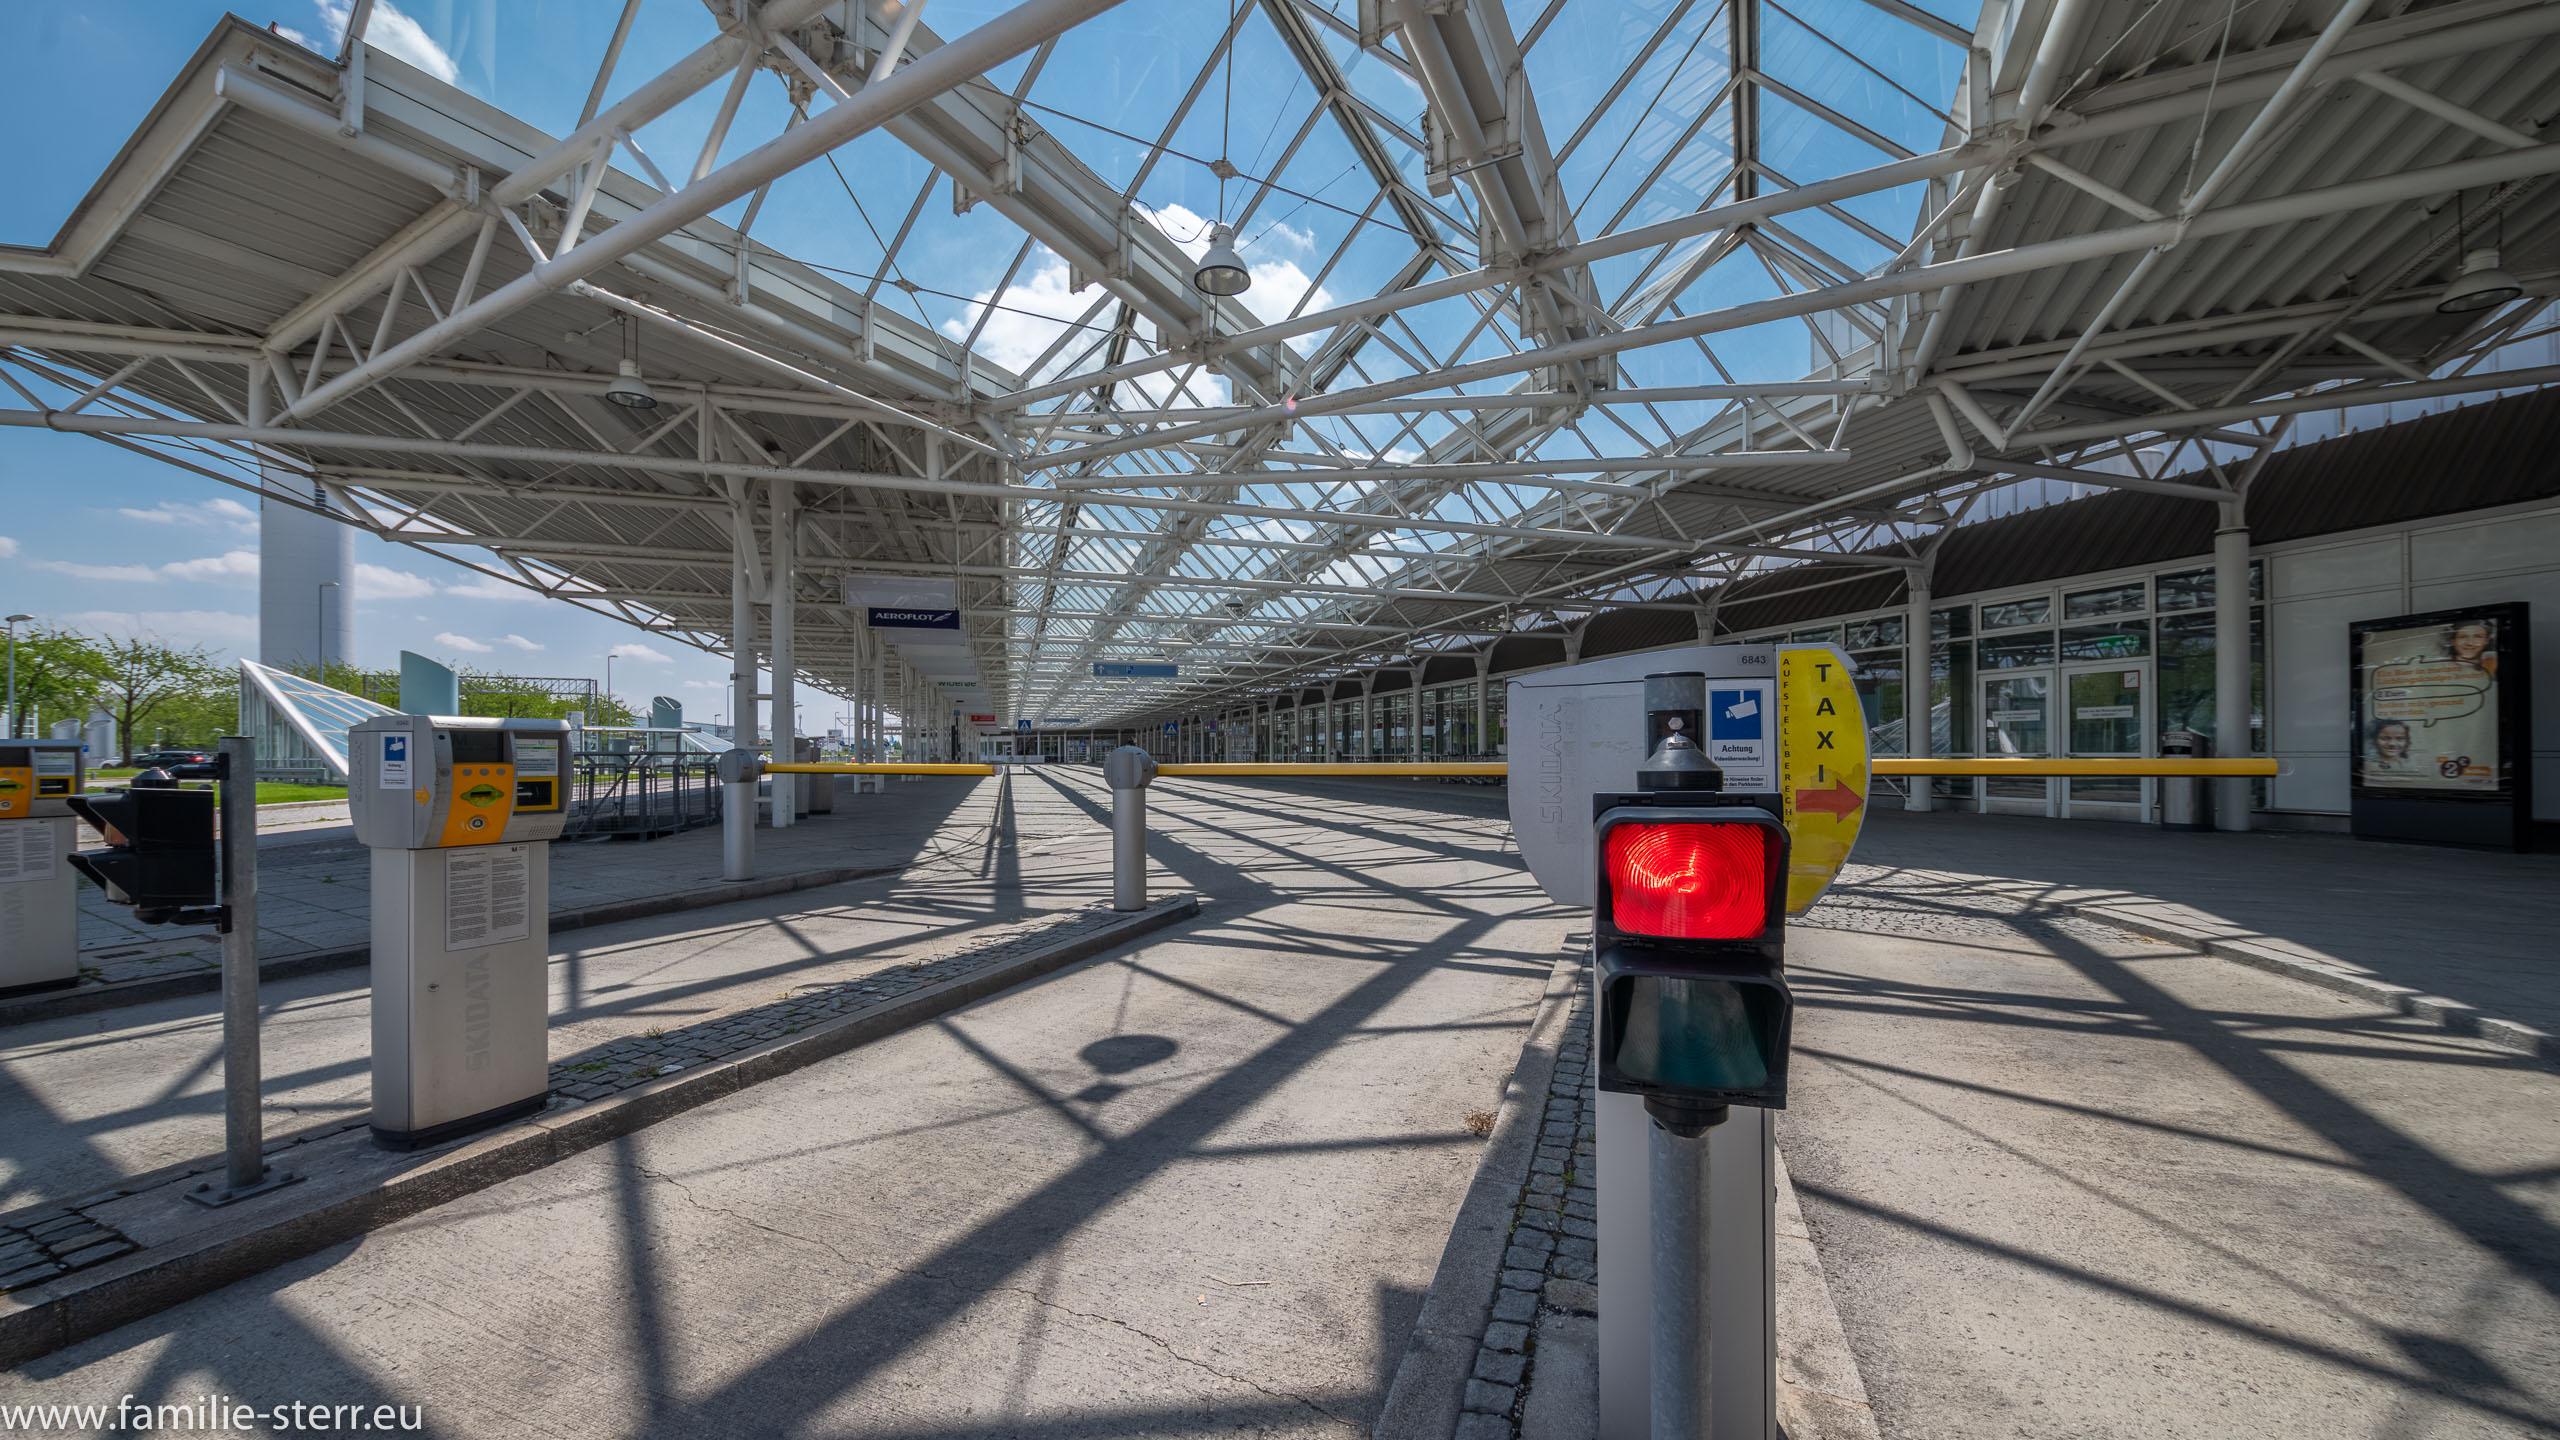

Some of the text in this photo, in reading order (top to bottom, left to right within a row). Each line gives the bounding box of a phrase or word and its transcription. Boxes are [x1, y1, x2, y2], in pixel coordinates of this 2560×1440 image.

[875, 612, 935, 621] AEROFLOT
[1741, 655, 1767, 665] 6843
[1815, 663, 1836, 783] TAXI
[1721, 744, 1753, 753] Achtung
[1540, 703, 1562, 824] SKIDATA
